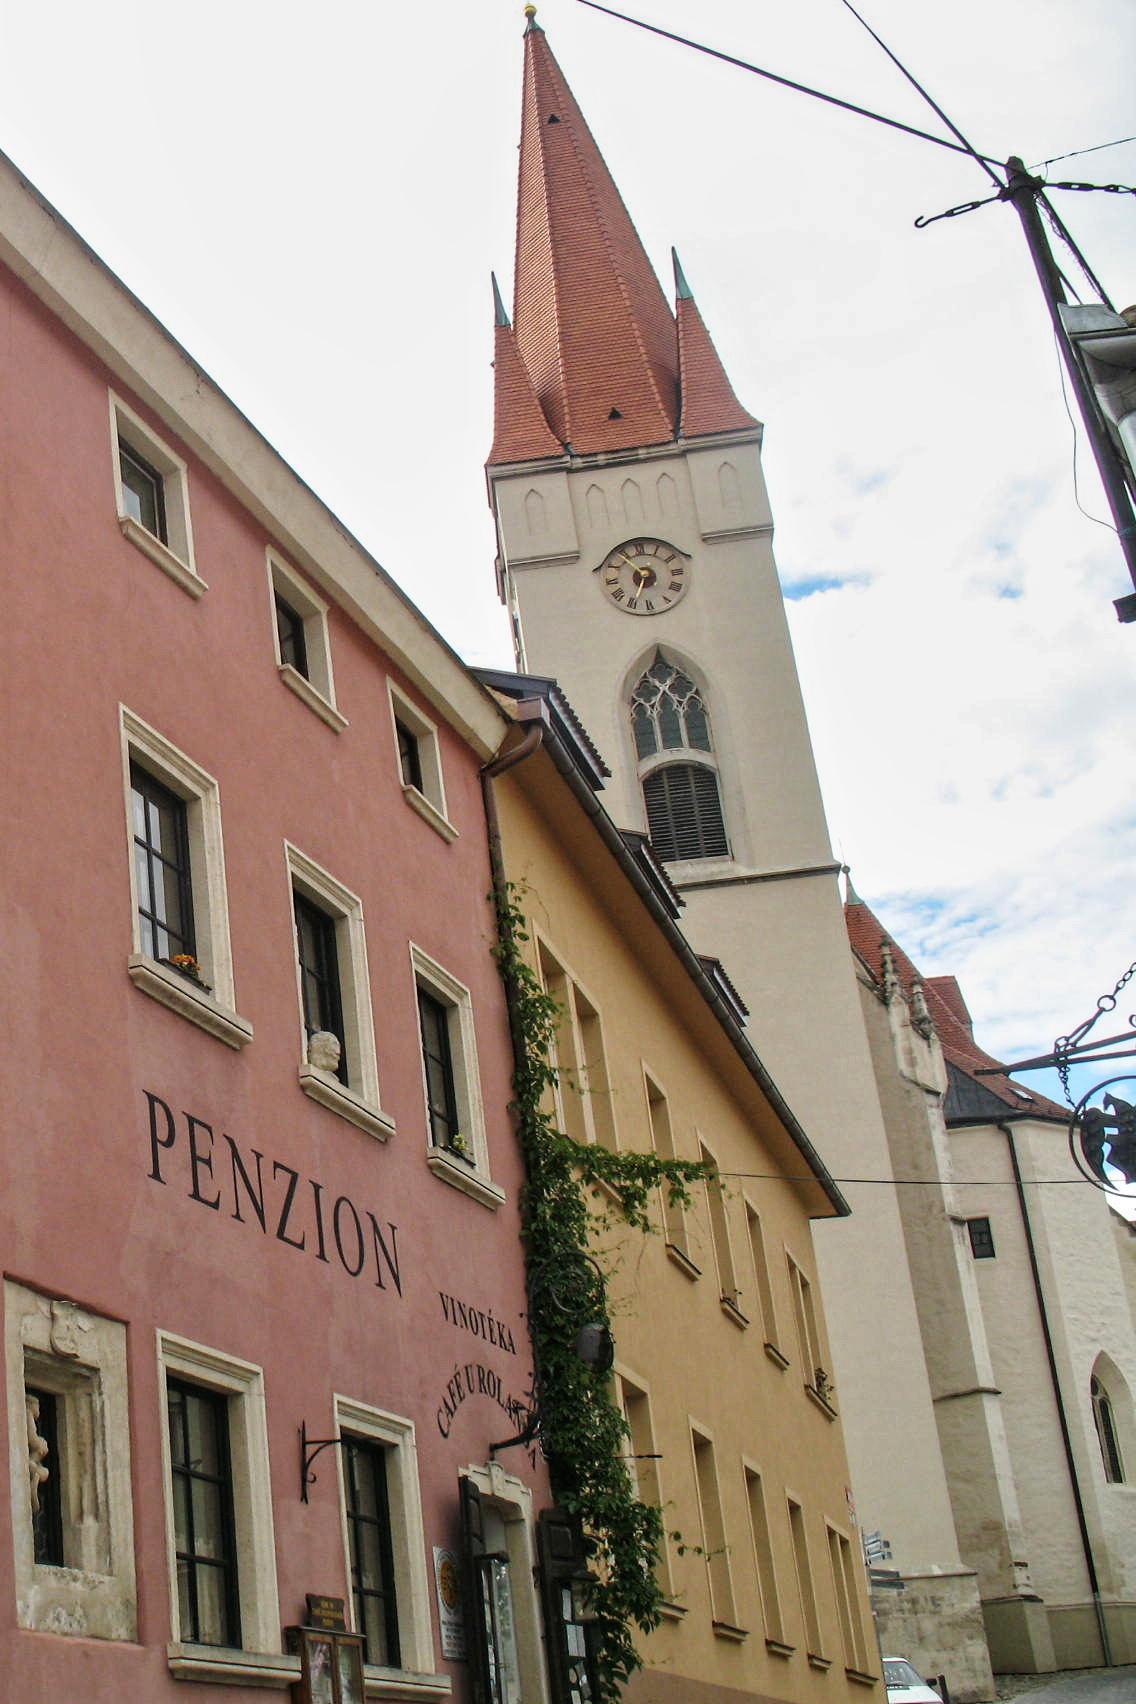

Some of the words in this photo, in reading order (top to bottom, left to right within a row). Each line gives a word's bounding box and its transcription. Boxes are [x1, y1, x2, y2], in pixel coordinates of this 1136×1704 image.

[142, 1089, 402, 1299] PENZION
[438, 1291, 516, 1355] VINOTÉKA
[437, 1361, 466, 1439] CAFÉ
[465, 1364, 476, 1394] U
